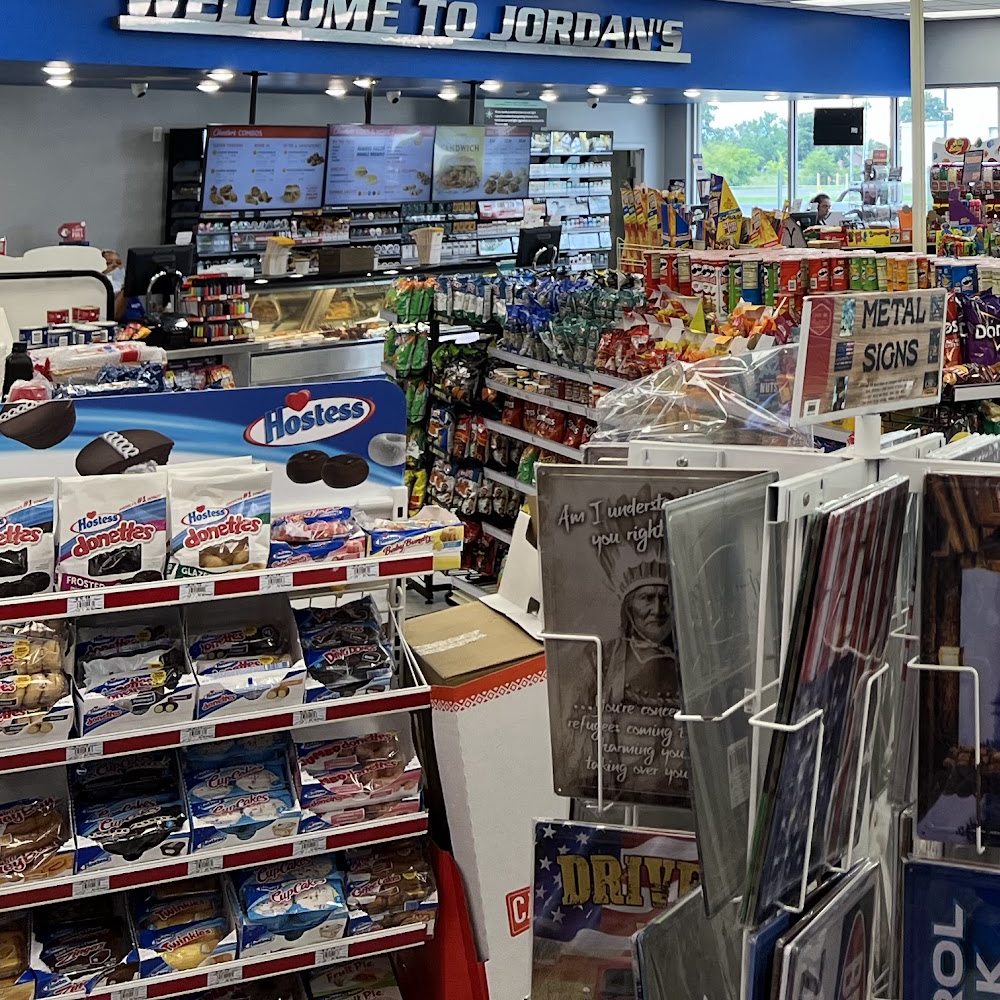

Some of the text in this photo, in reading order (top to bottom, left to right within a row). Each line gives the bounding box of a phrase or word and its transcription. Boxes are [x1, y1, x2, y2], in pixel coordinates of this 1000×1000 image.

[490, 5, 684, 54] JORDAN'S
[238, 129, 263, 137] COMBOS
[441, 144, 480, 153] SANDWICH
[862, 297, 926, 329] METAL
[862, 338, 918, 373] SIGNS
[264, 401, 364, 444] Hostess
[78, 513, 118, 531] Hostess
[188, 509, 225, 524] Hostess
[558, 493, 667, 533] Am I underst
[0, 525, 42, 545] ettes
[73, 522, 154, 557] donettes
[185, 515, 261, 548] donettes
[592, 519, 664, 557] you right
[383, 543, 405, 556] Baby
[181, 567, 209, 578] GLAZ
[325, 645, 378, 665] DING DONGS
[203, 693, 238, 710] donettes
[640, 706, 681, 717] conce
[342, 732, 393, 749] donettes
[626, 724, 672, 747] coming
[207, 764, 264, 788] CupCakes
[320, 773, 346, 785] MBO
[633, 765, 658, 775] over
[211, 792, 270, 814] CupCakes
[256, 857, 313, 882] CupCakes
[271, 878, 326, 903] CupCak
[156, 900, 206, 920] Twinkies
[161, 928, 212, 952] Twinkies
[327, 961, 373, 983] Fruit Pie
